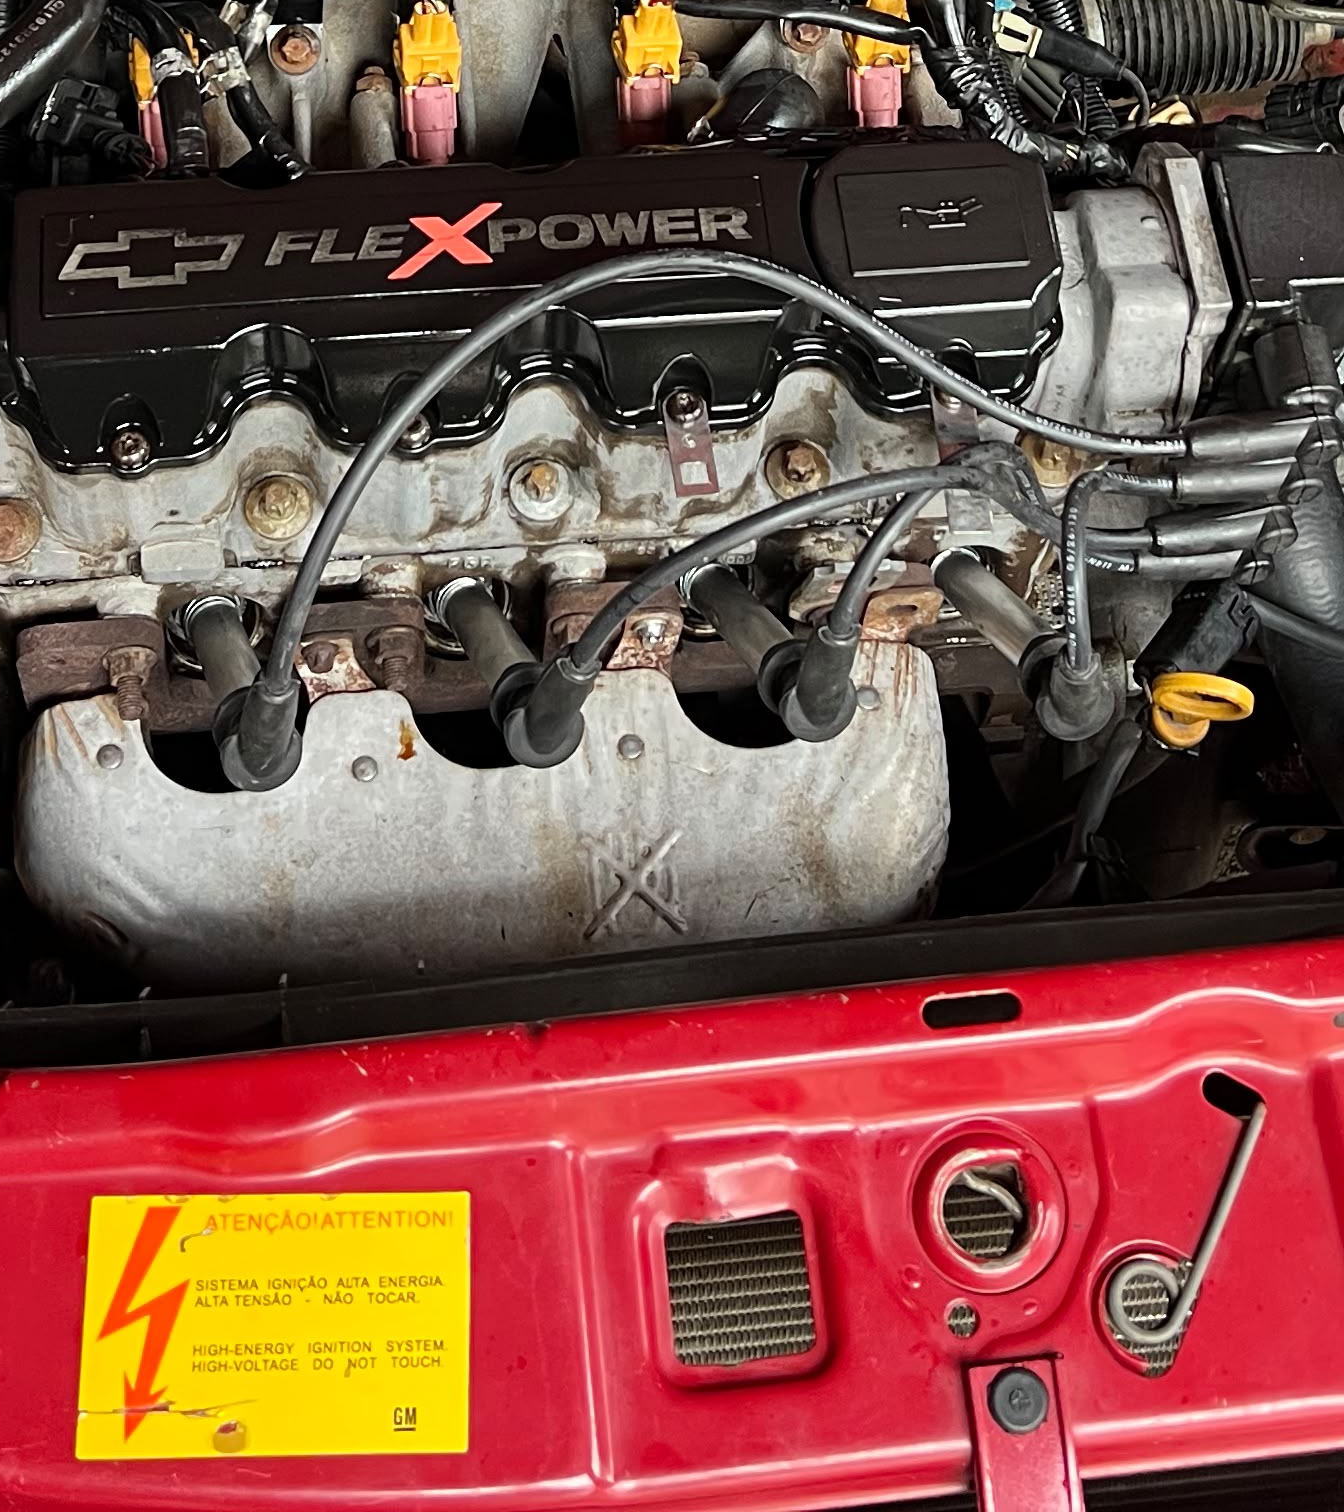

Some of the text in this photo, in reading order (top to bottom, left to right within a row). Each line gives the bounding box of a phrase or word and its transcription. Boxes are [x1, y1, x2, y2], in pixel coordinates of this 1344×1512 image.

[196, 1278, 258, 1292] SISTEMA
[267, 1275, 328, 1292] IGNIÇÃO
[337, 1276, 370, 1289] ALTA
[195, 1294, 228, 1307] ALTA
[235, 1292, 292, 1306] TENSÃO
[323, 1291, 354, 1305] NÃO
[192, 1342, 295, 1356] HIGH-ENERGY
[308, 1341, 372, 1354] IGNITION
[192, 1358, 299, 1372] HIGH-VOLTAGE
[313, 1357, 334, 1371] DO
[347, 1356, 377, 1370] NOT
[393, 1407, 417, 1426] GM
